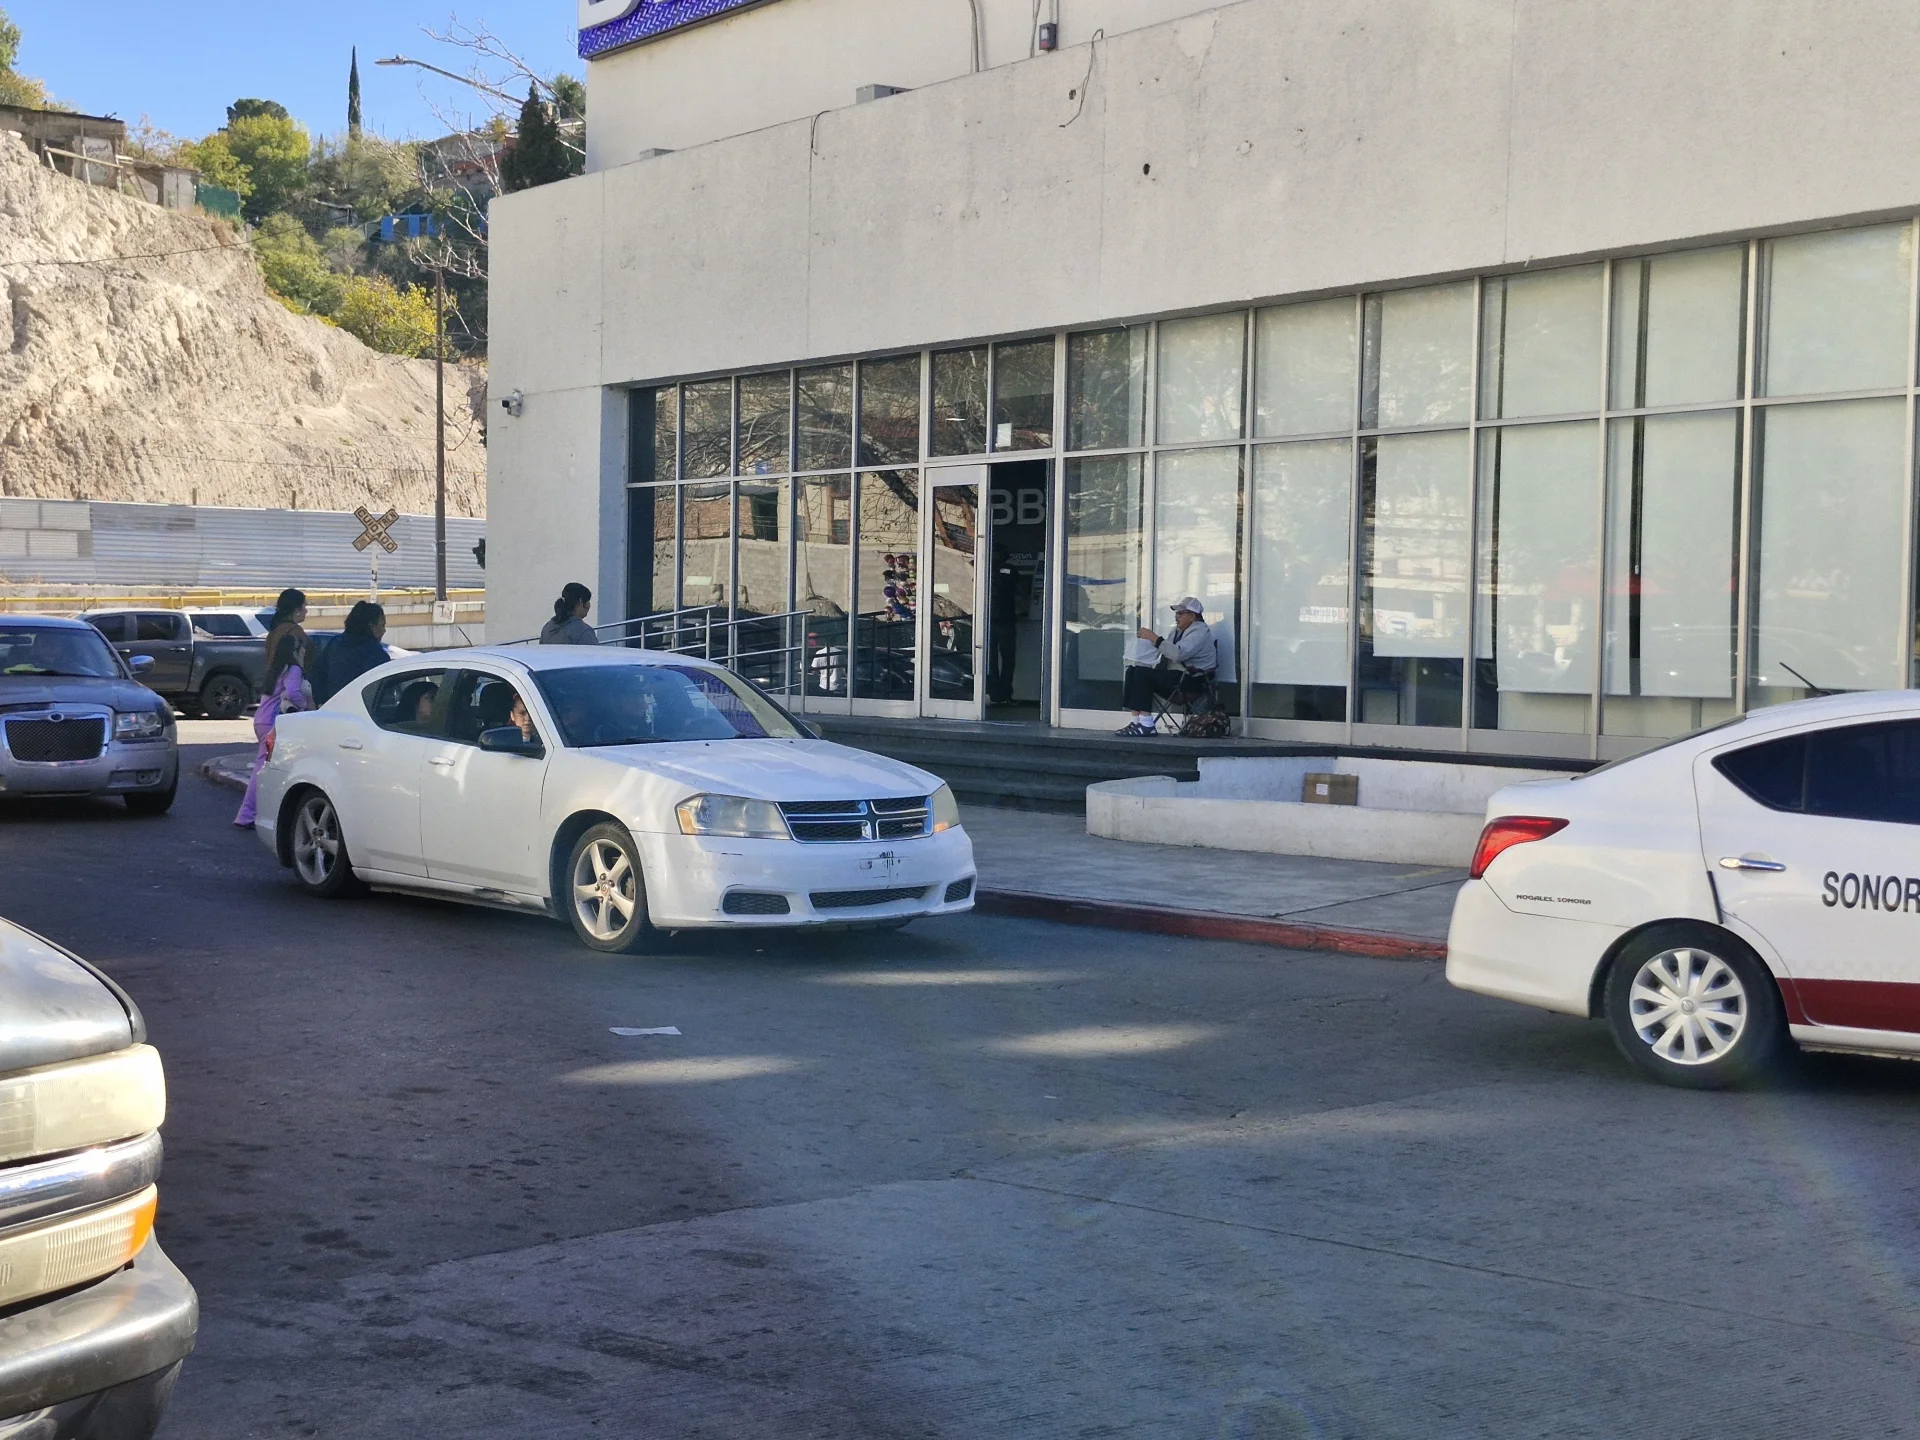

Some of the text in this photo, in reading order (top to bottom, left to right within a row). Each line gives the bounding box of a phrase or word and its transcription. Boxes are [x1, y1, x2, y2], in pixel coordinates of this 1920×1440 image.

[378, 511, 397, 529] TREN
[990, 488, 1046, 525] BB
[358, 509, 395, 551] CUIDADO
[1556, 897, 1592, 905] SONORA
